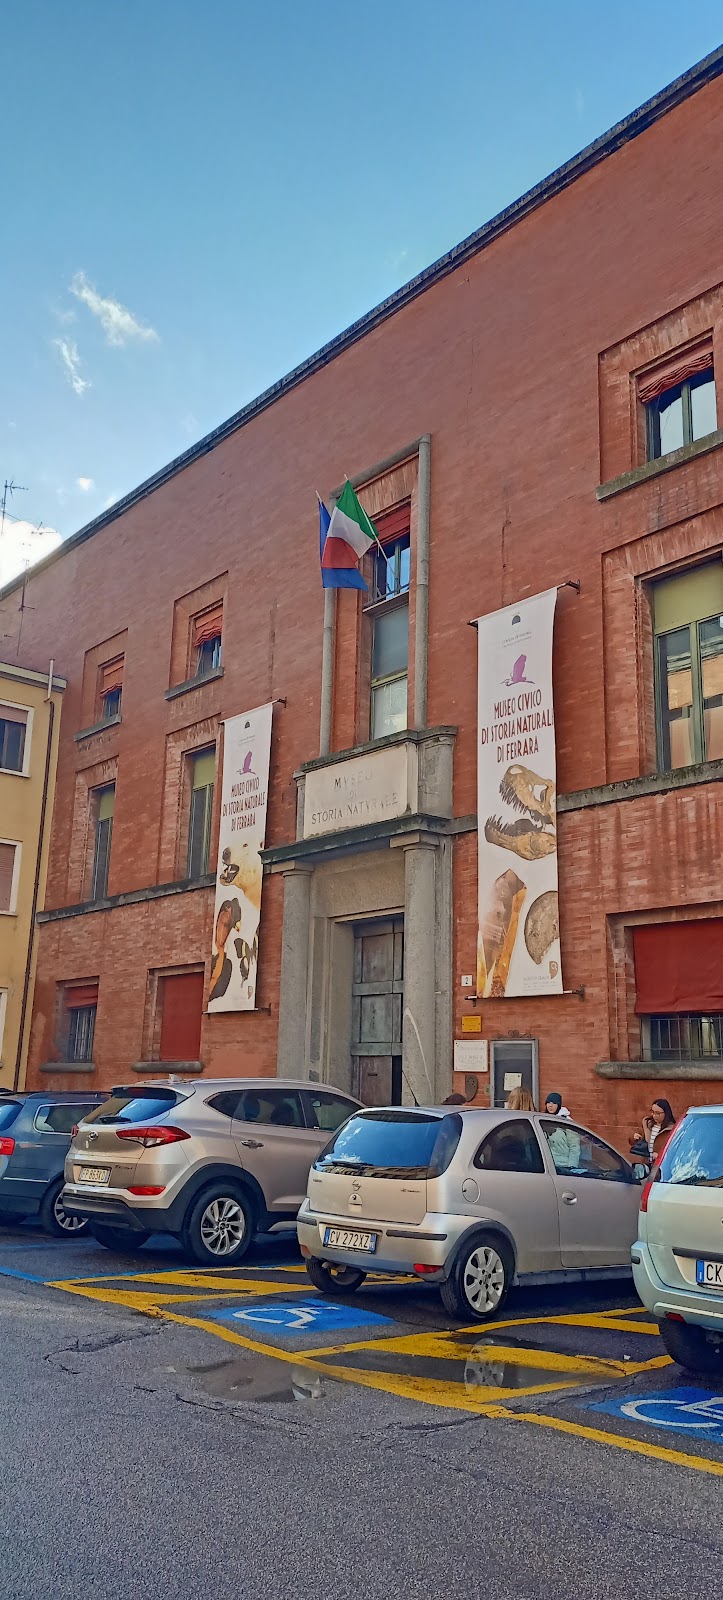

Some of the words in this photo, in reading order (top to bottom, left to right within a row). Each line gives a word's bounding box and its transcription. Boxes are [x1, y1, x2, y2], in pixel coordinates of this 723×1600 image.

[493, 696, 516, 720] MUSEO
[517, 688, 542, 712] CIVICO
[481, 727, 489, 745] DI
[491, 720, 516, 742] STORIA
[496, 745, 505, 763] DI
[506, 735, 539, 760] FERRARA
[231, 781, 245, 798] MUSEO
[245, 776, 260, 793] CIVICO
[222, 803, 228, 817] DI
[228, 799, 244, 816] STORIA
[244, 791, 266, 811] NATURALE
[231, 817, 236, 832] DI
[236, 812, 256, 831] FERRARA
[311, 807, 343, 825] STORIA
[464, 976, 469, 985] 2
[329, 1230, 341, 1244] CV
[342, 1232, 370, 1249] 272XZ
[706, 1263, 723, 1283] CK
